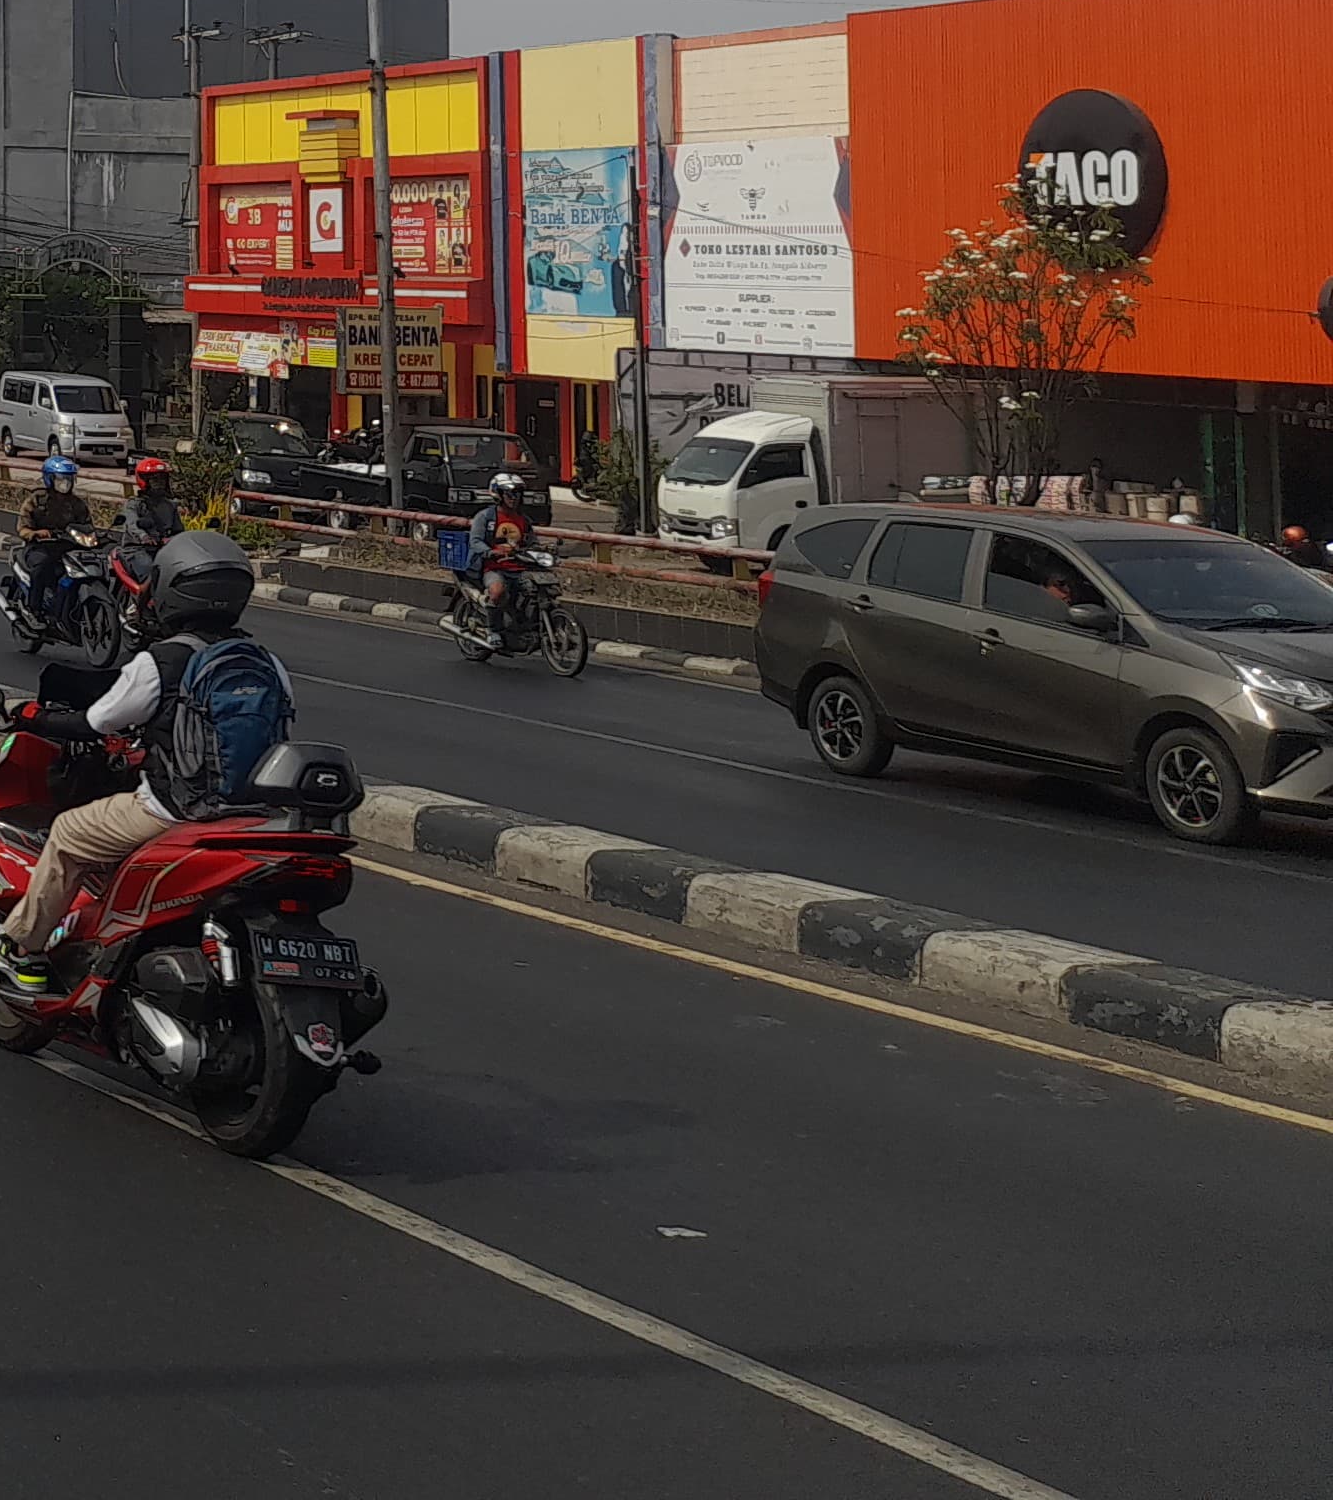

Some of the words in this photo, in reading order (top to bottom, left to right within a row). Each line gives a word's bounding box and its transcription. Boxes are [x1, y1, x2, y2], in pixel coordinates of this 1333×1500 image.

[1029, 149, 1139, 206] TACO
[530, 208, 565, 225] Bank
[571, 208, 620, 225] BENTA
[694, 244, 722, 256] TOKO
[725, 244, 771, 256] LESTARI
[775, 244, 828, 256] SANTOSO
[348, 325, 381, 346] BAN
[395, 326, 439, 347] BENTA
[354, 352, 382, 366] KRE
[399, 353, 434, 366] CEPAT
[260, 936, 274, 954] W
[278, 938, 317, 959] 6620
[322, 943, 352, 963] NBT
